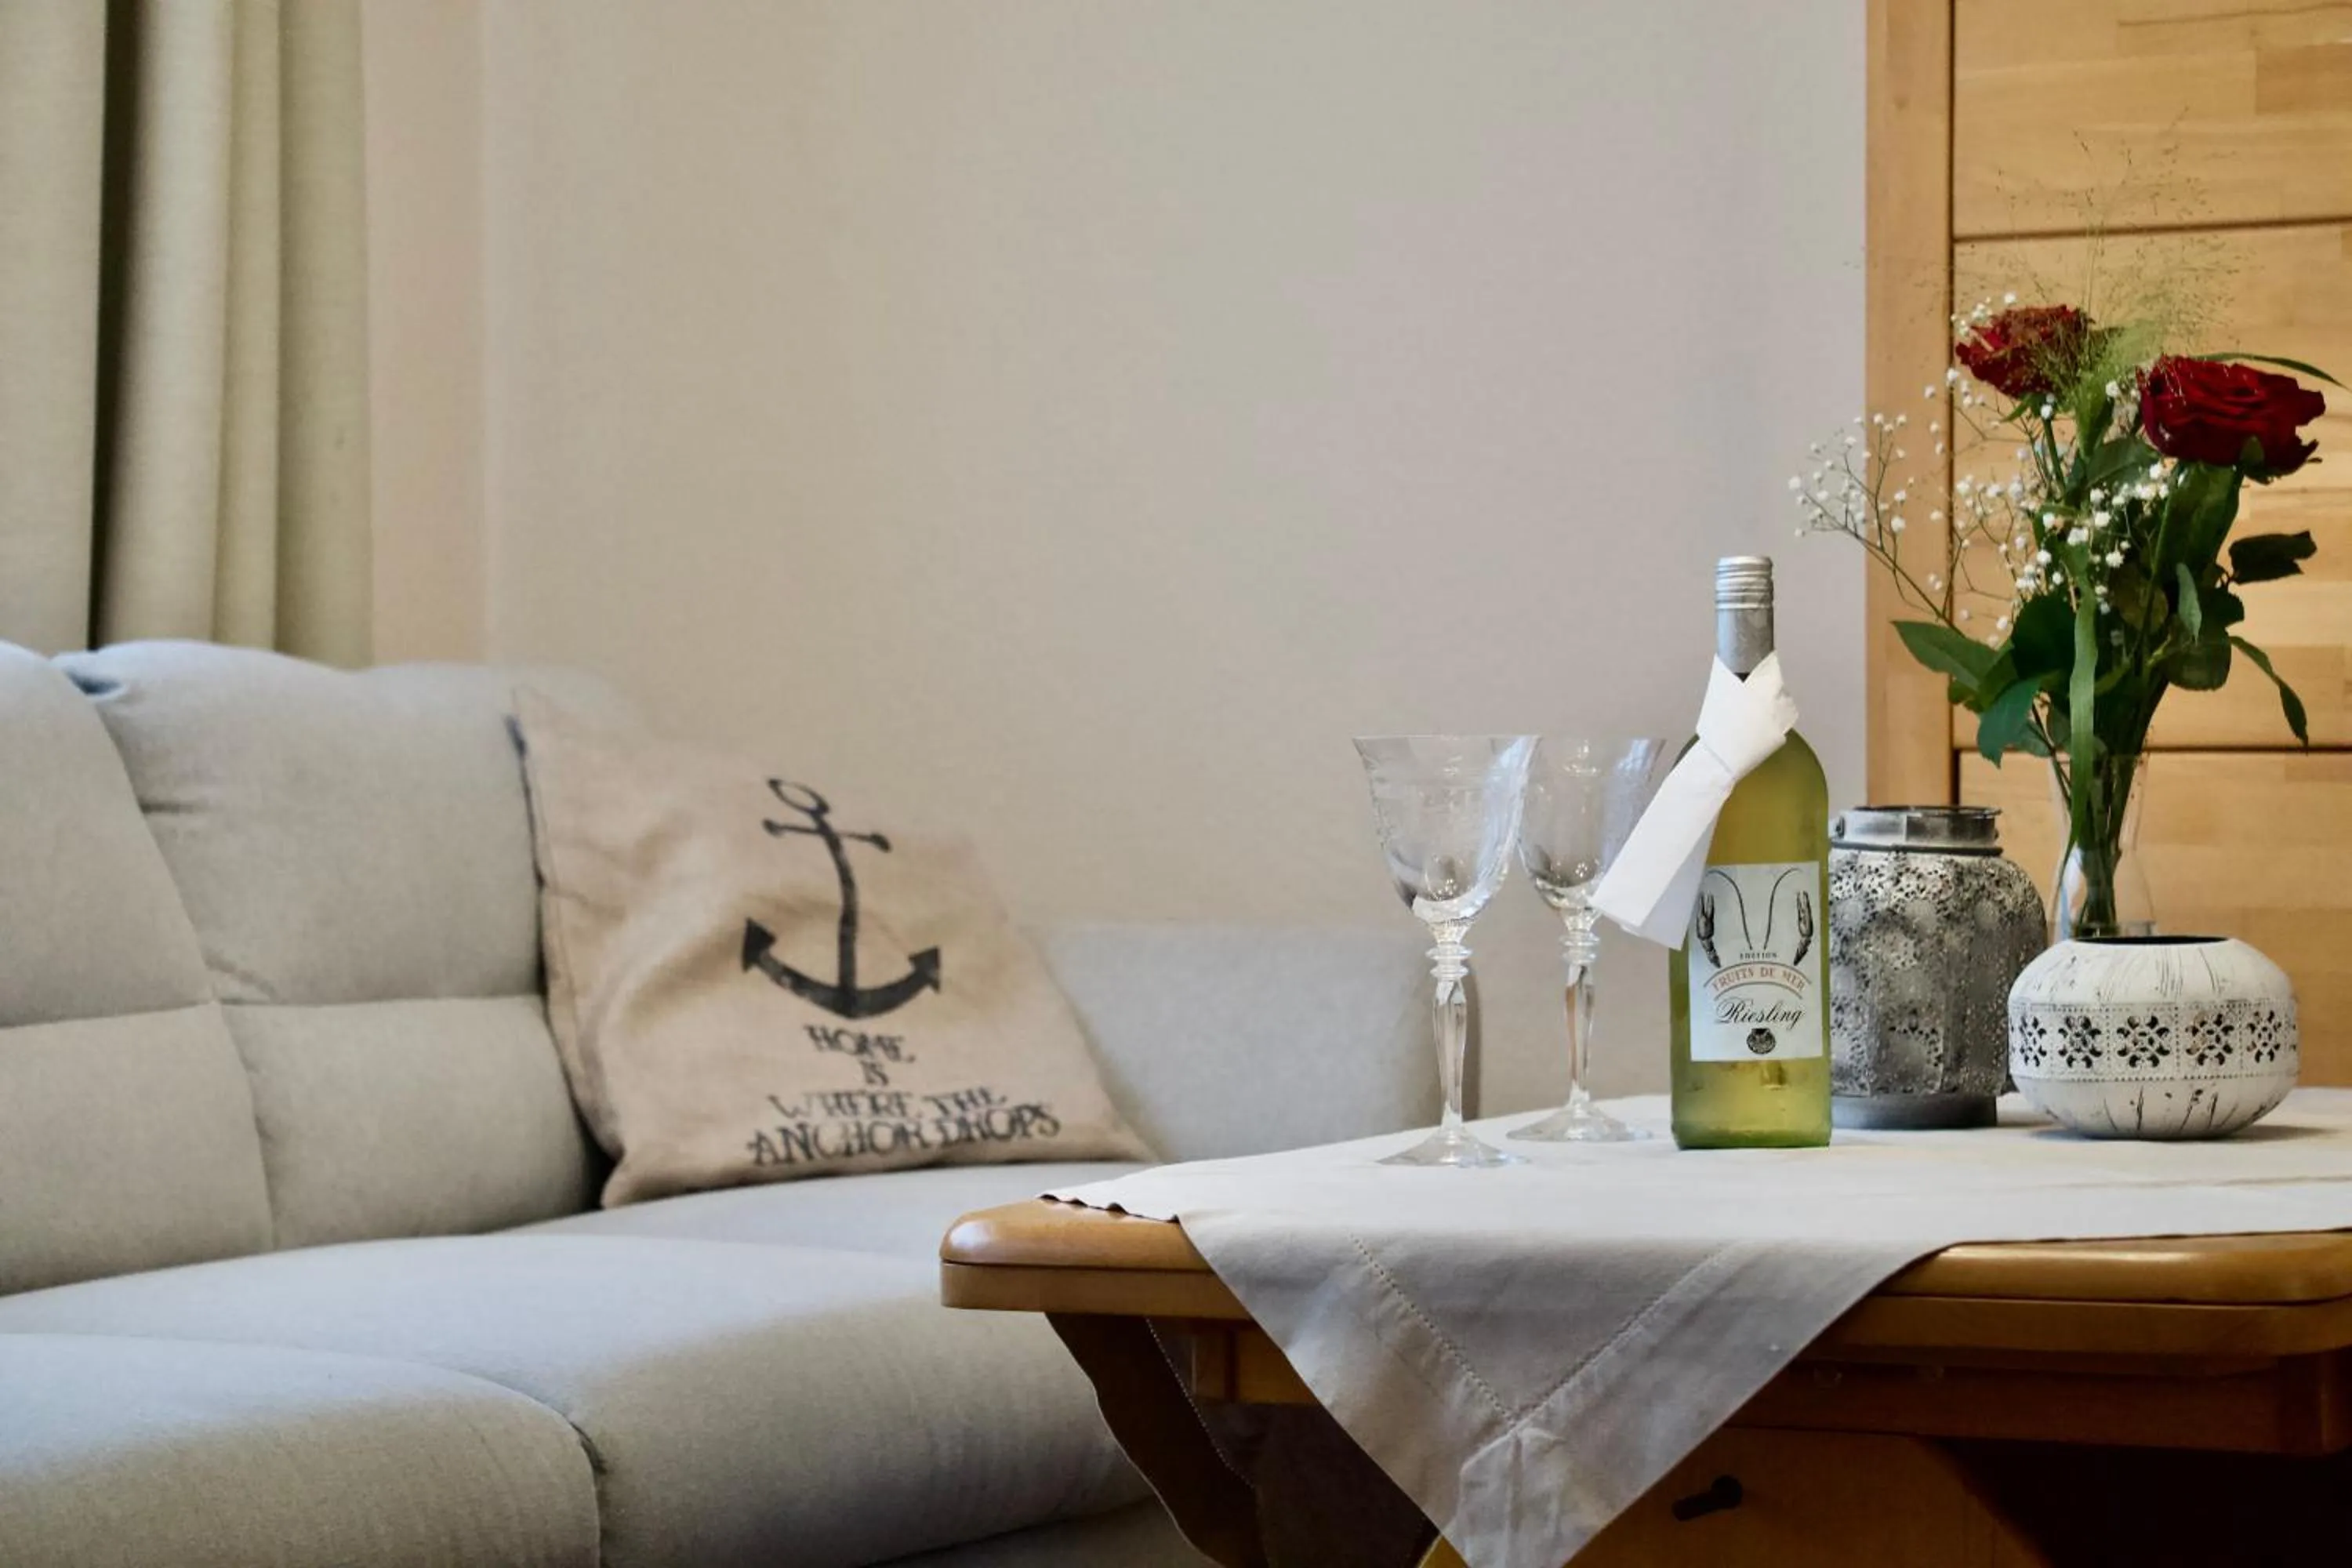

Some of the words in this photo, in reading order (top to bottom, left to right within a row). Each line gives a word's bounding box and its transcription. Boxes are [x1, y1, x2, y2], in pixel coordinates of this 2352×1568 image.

[1712, 965, 1755, 992] FRUITS
[1761, 965, 1776, 977] DE
[1783, 970, 1806, 991] MER
[1715, 996, 1805, 1031] Riesling
[804, 1024, 915, 1062] HOME
[860, 1060, 889, 1087] IS
[768, 1091, 923, 1120] WHERE
[924, 1086, 1008, 1117] THE
[746, 1120, 931, 1167] ANCHOR
[935, 1102, 1062, 1146] DROPS
